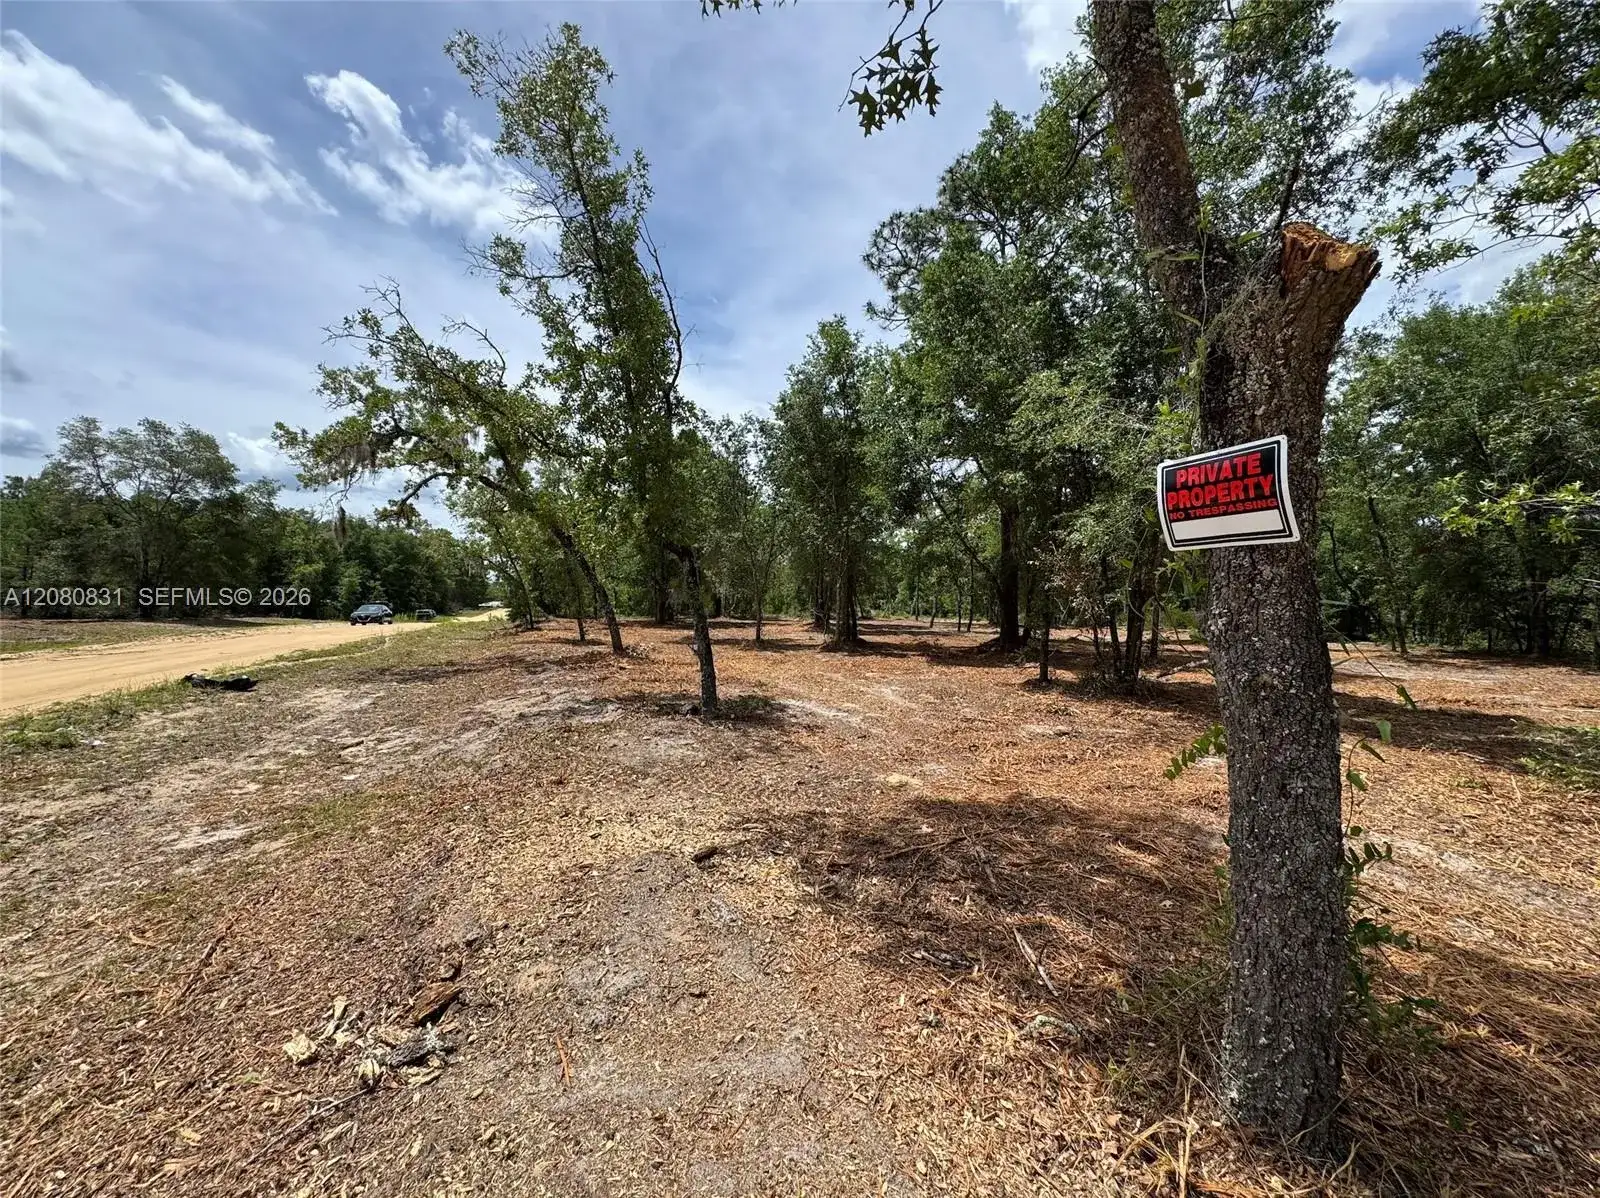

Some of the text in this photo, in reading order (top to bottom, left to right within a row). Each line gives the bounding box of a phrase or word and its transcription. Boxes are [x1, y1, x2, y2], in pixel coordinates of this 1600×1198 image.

[1176, 452, 1261, 488] PRIVATE
[1166, 474, 1273, 510] PROPERTY
[1169, 498, 1278, 520] NO TRESPASSING
